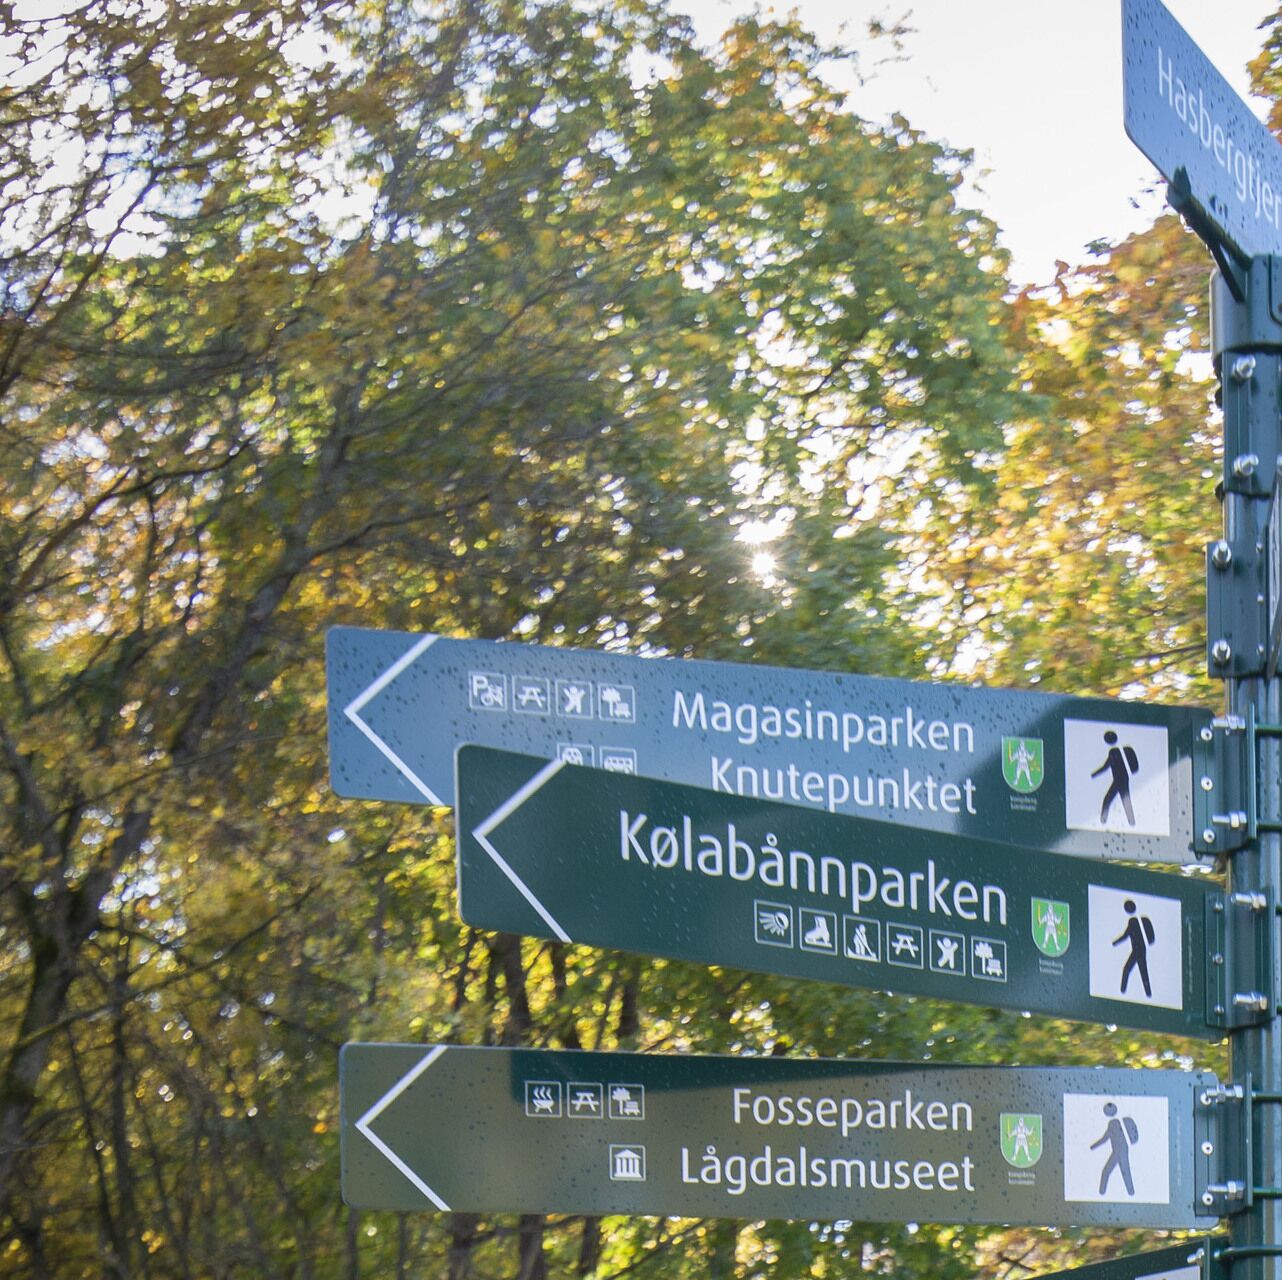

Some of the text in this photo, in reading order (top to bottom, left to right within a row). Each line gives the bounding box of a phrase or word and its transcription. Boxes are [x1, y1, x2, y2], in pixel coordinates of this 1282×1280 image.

[673, 691, 975, 753] Magasinparken
[711, 756, 977, 814] Knutepunktet
[620, 810, 1008, 927] Kølabånnparken
[733, 1088, 973, 1138] Fosseparken
[681, 1145, 975, 1195] Lågdalsmuseet
